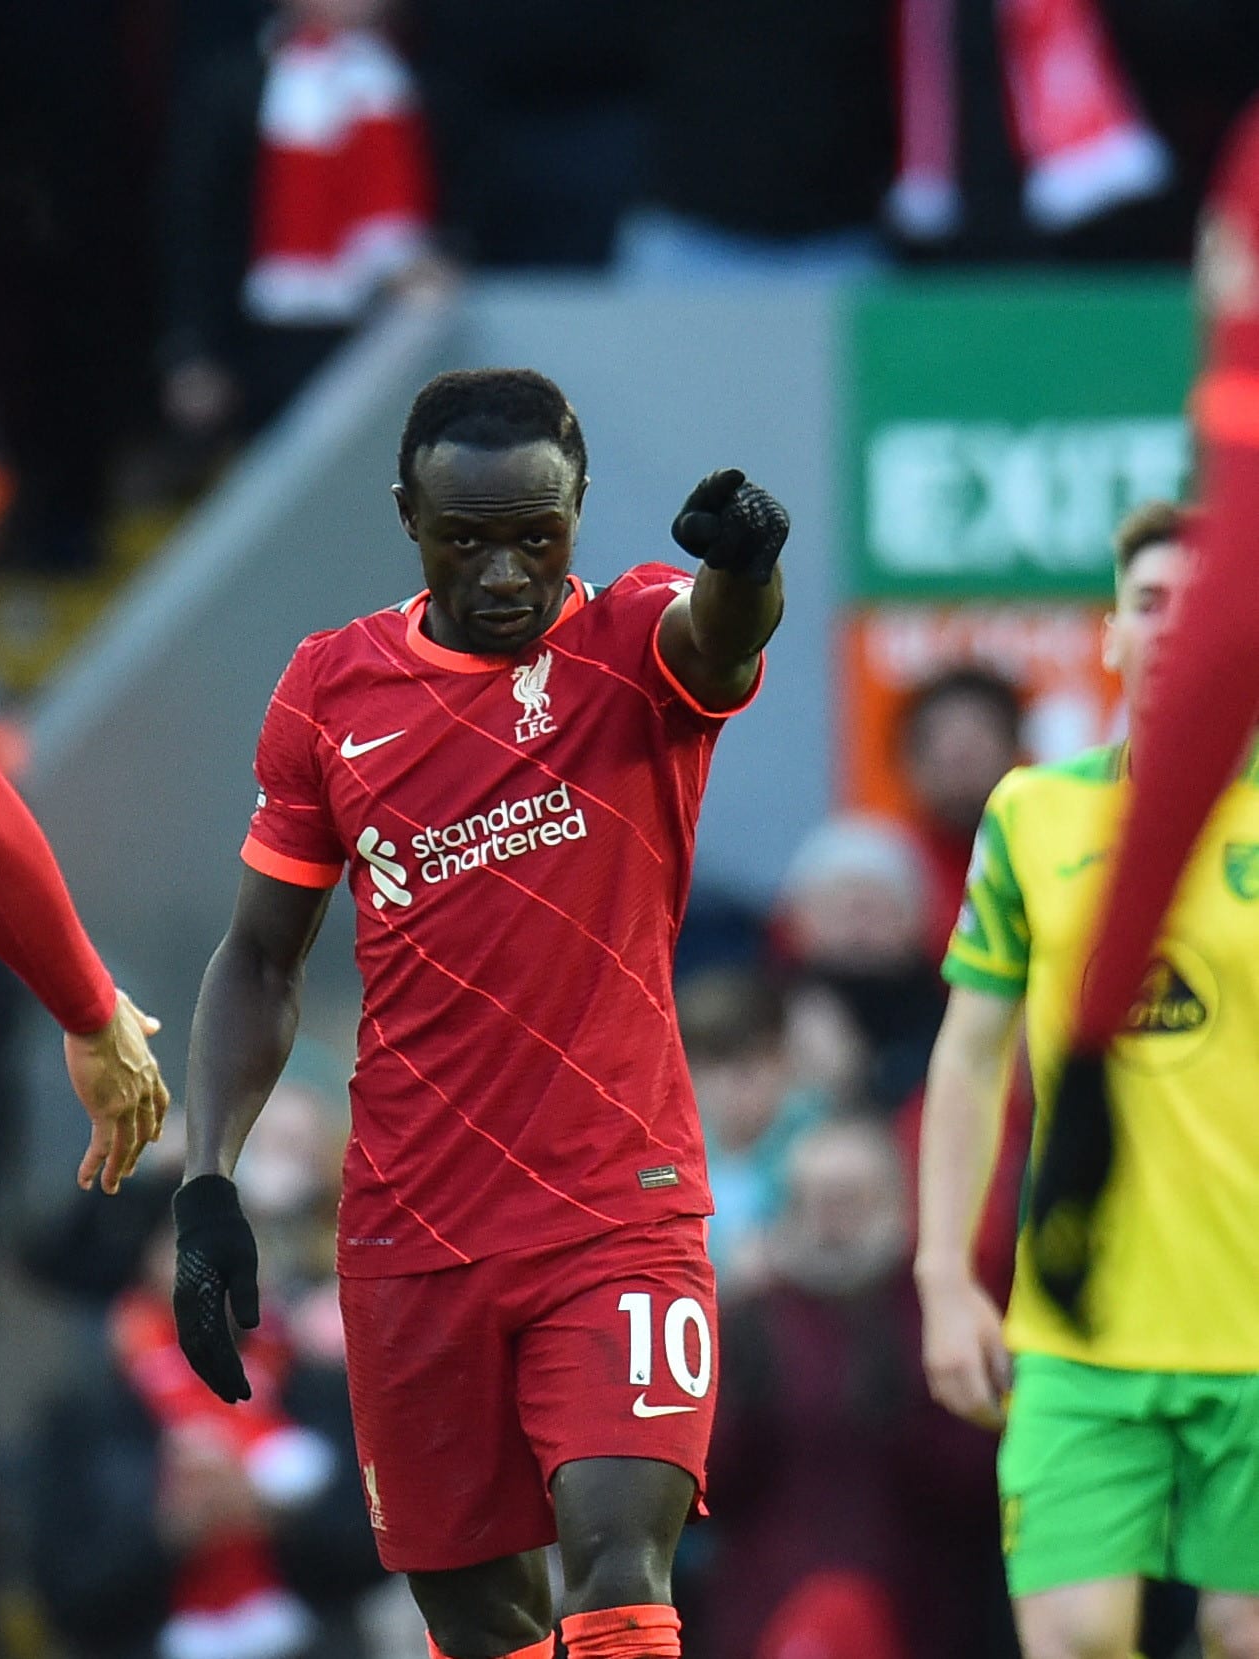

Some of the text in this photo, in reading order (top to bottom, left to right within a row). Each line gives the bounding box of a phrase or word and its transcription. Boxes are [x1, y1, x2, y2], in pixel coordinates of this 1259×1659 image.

[866, 416, 1193, 575] EXIT
[411, 781, 571, 859] standard
[421, 808, 587, 884] chartered
[617, 1292, 713, 1399] 10
